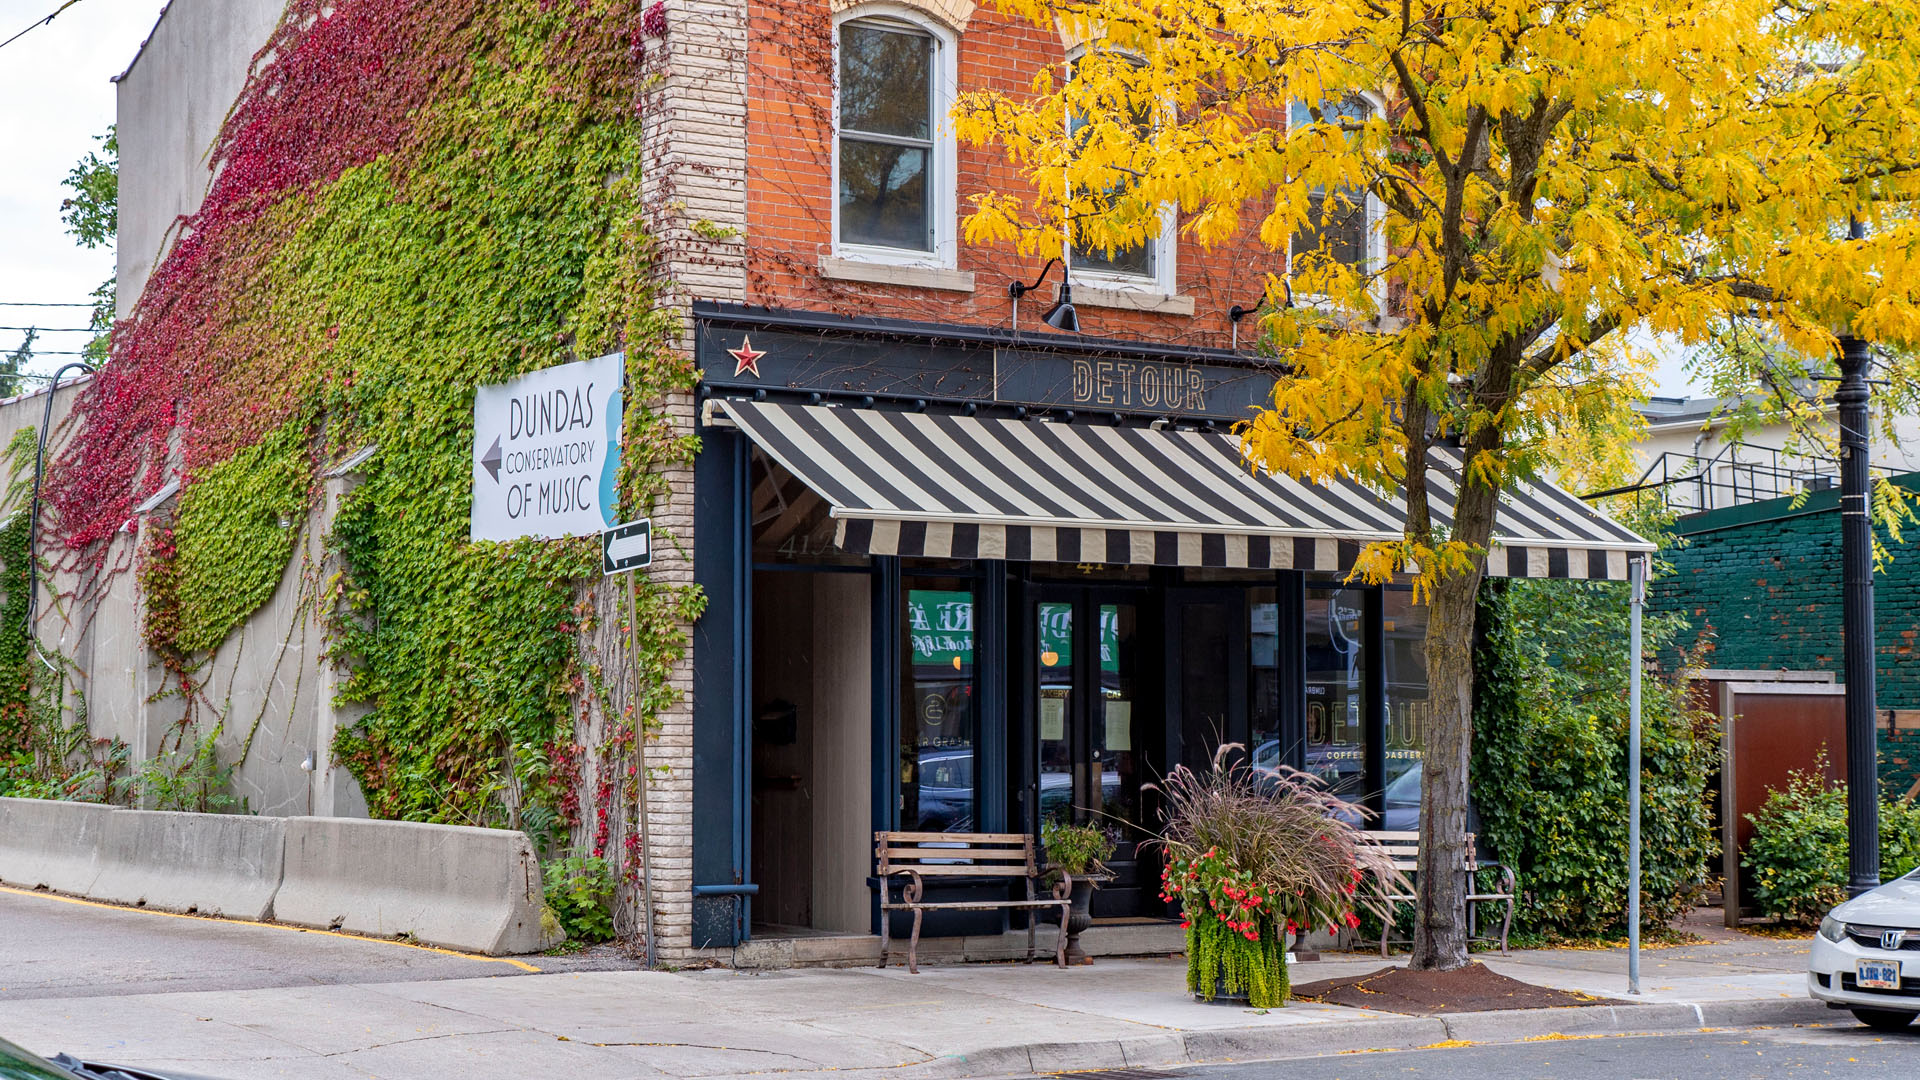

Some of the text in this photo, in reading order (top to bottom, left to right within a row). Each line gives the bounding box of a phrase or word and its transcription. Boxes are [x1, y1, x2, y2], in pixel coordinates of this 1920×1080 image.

[1073, 360, 1206, 411] DETOUR
[510, 382, 594, 441] DUNDAS
[506, 440, 596, 474] CONSERVATORY
[507, 474, 592, 519] OF MUSIC
[1040, 689, 1070, 698] AKERY
[1326, 751, 1425, 760] COFFEE OASTERS
